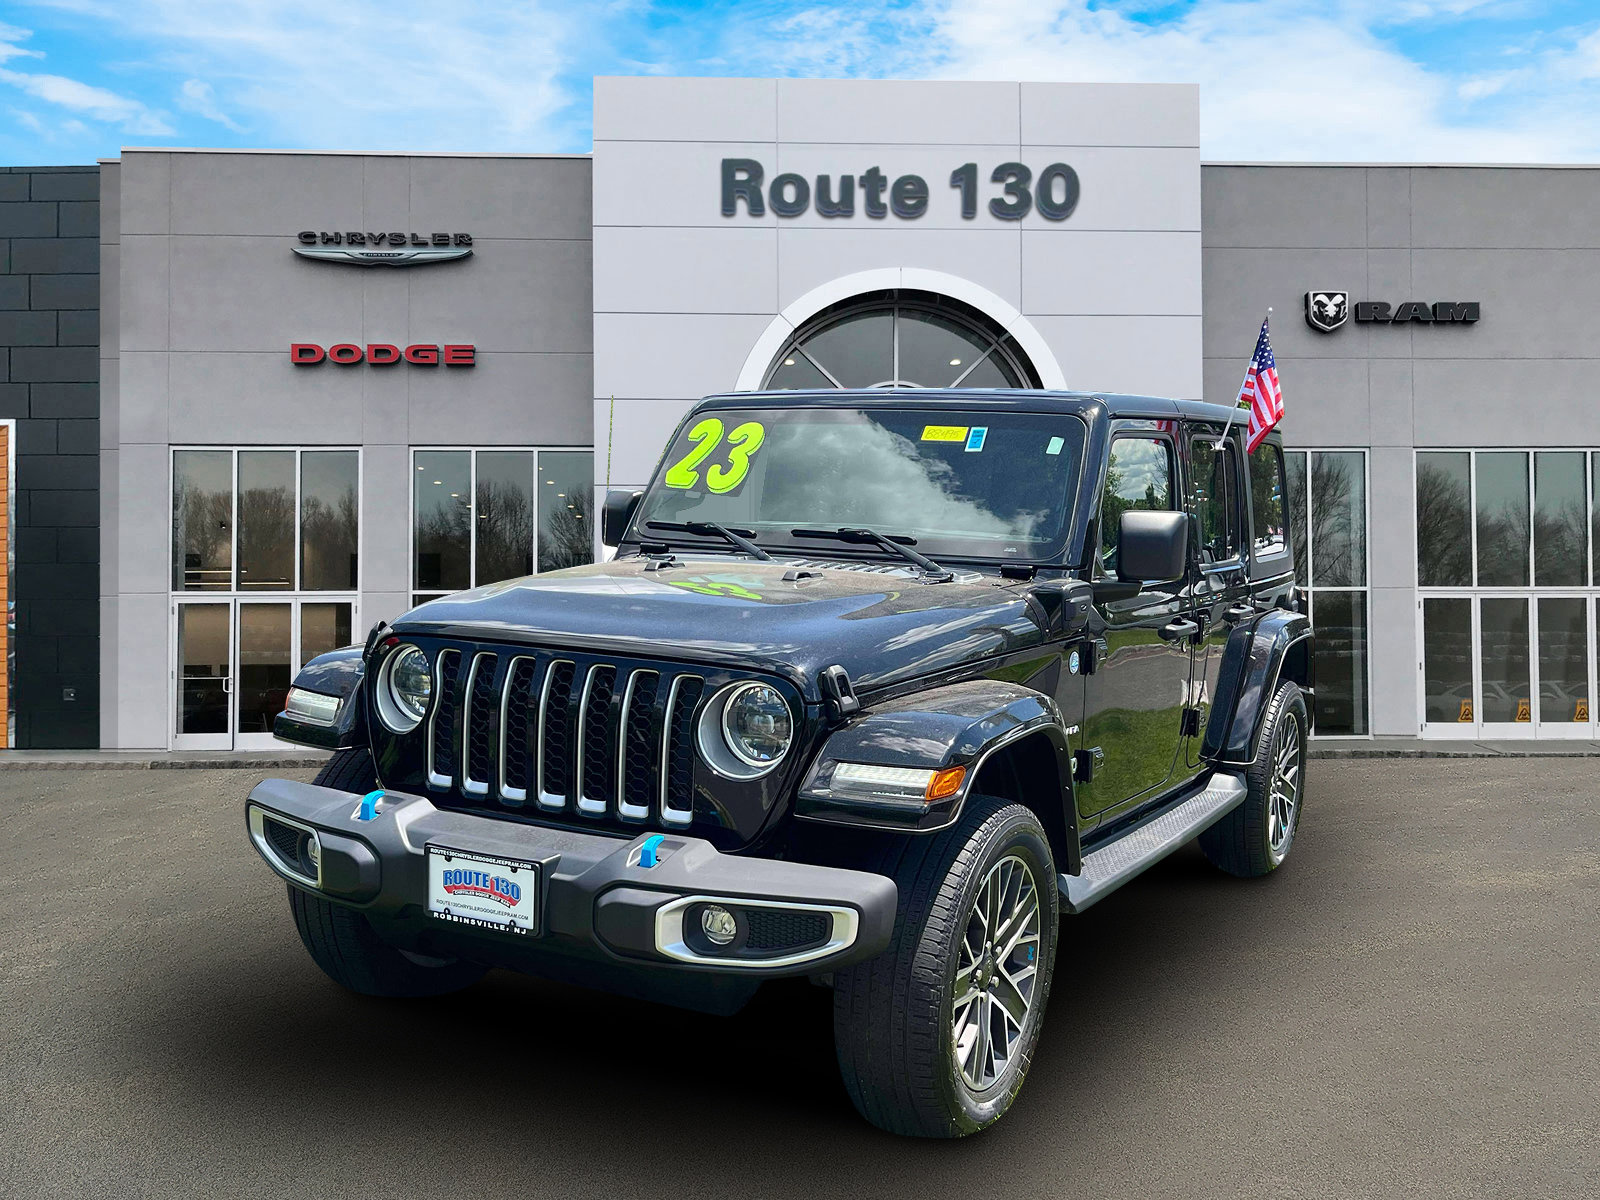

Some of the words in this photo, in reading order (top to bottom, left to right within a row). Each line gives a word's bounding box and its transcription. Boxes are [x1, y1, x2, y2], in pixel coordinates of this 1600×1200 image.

[721, 158, 929, 218] Route
[950, 162, 1080, 221] 130
[298, 231, 473, 245] CHRYSLER
[1355, 302, 1480, 323] RAM
[291, 344, 475, 366] DODGE
[665, 418, 765, 494] 23
[443, 869, 490, 888] ROUTE
[493, 876, 521, 900] 130
[433, 912, 510, 931] ROBBINSVILLE,
[514, 926, 527, 935] NJ
